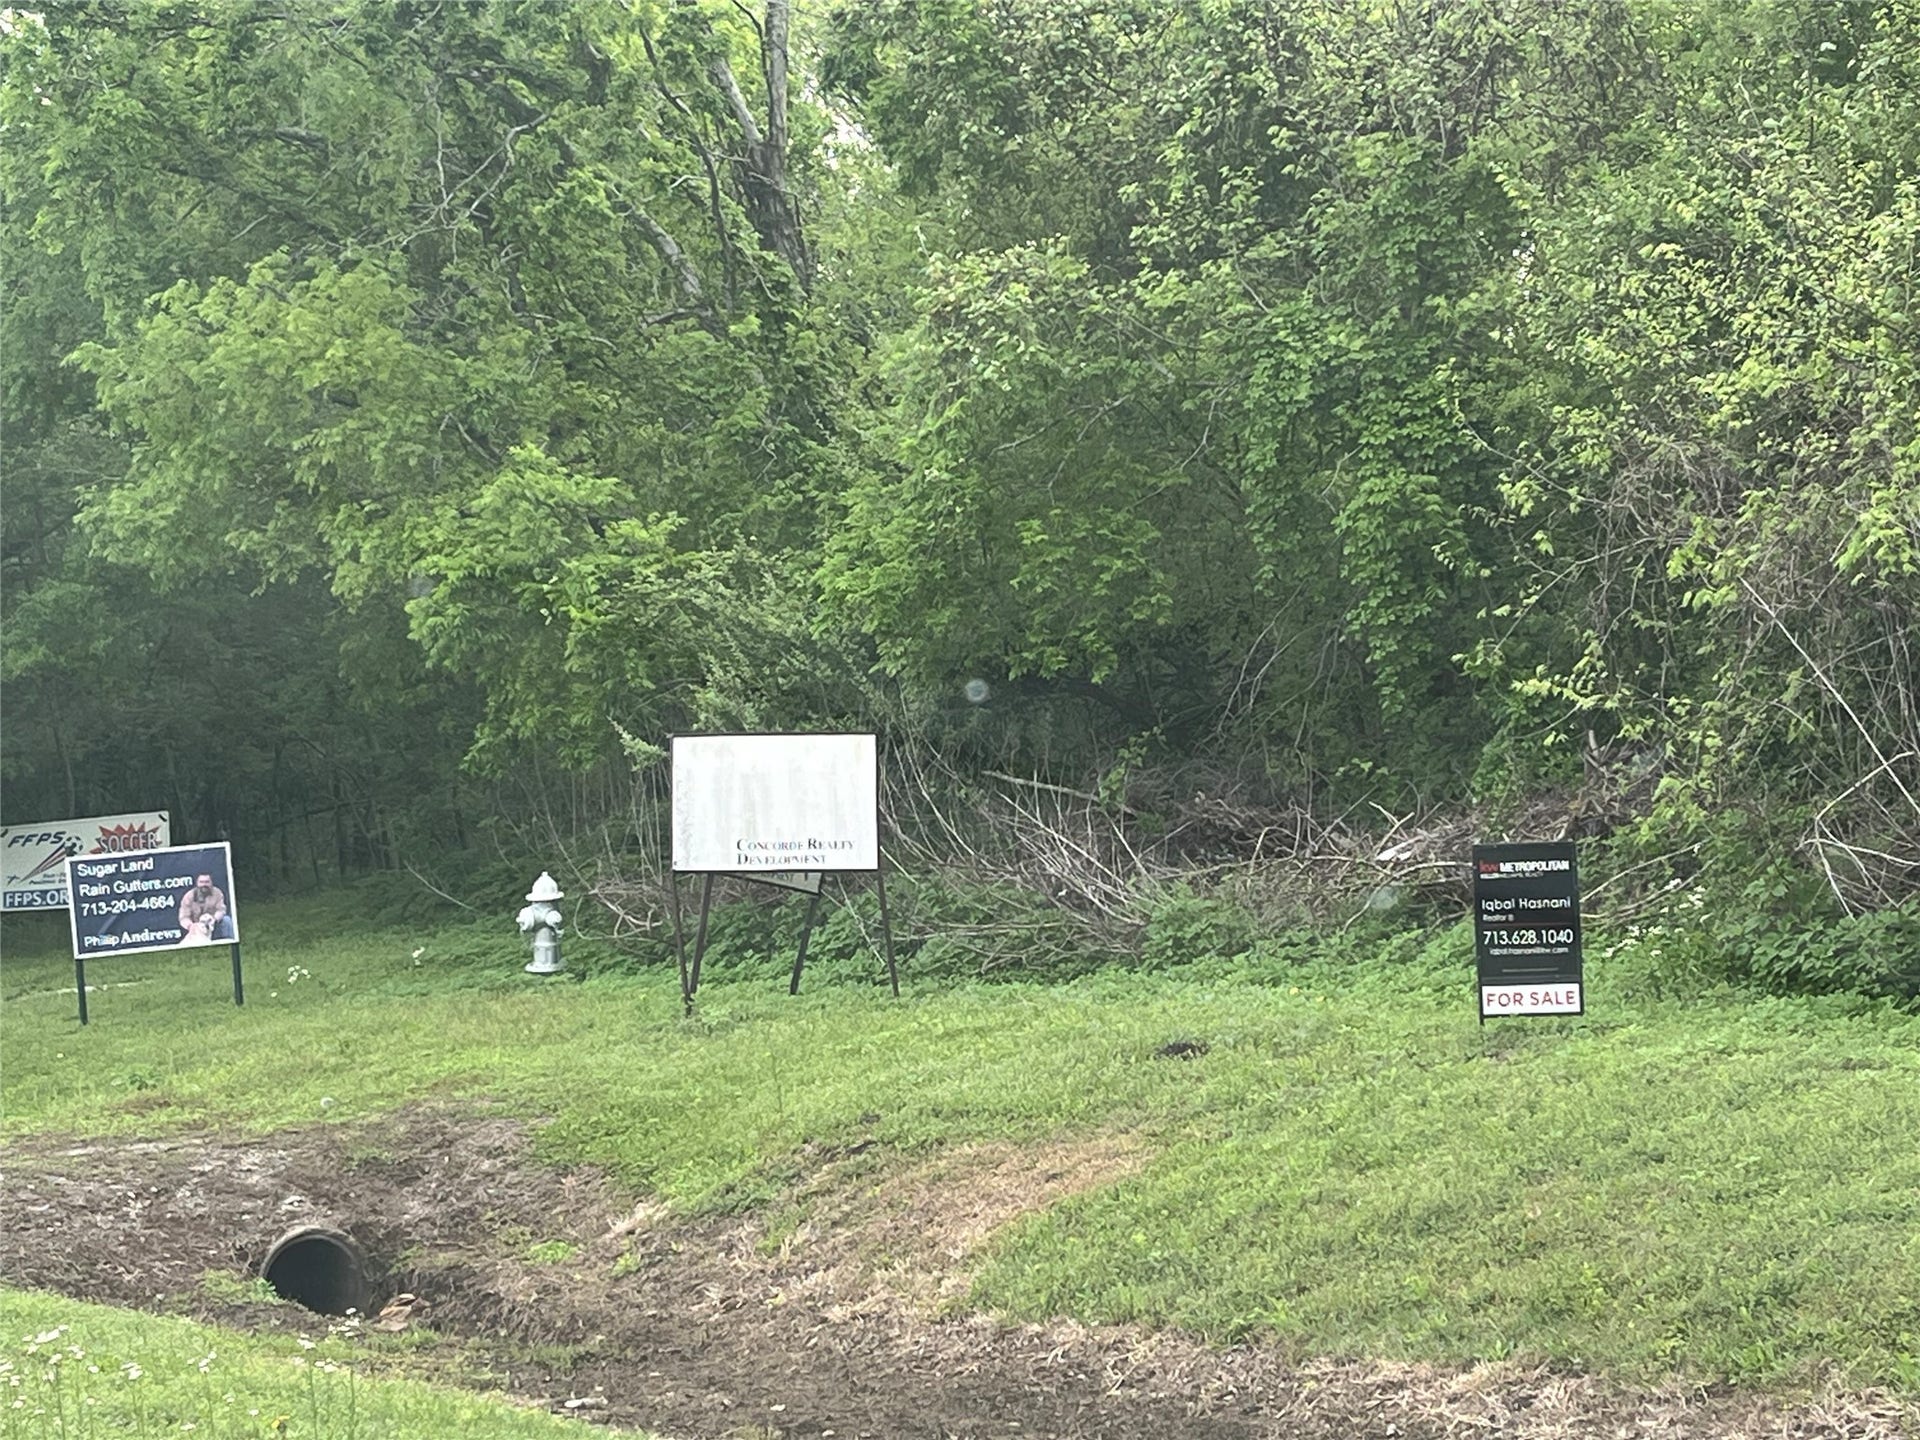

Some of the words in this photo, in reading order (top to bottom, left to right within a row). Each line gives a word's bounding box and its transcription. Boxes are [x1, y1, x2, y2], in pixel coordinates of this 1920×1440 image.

[8, 831, 67, 848] FFPS
[100, 831, 158, 853] SOCCER
[77, 863, 118, 878] Sugar
[120, 857, 154, 873] Land
[1499, 860, 1570, 873] METROPOLITAN
[79, 883, 110, 897] Rain
[113, 876, 193, 894] Gutters.com
[81, 895, 175, 917] 713-204-4664
[1481, 900, 1516, 912] Iqbal
[1519, 897, 1571, 910] Hasnani
[121, 929, 182, 945] Andrews
[1483, 929, 1574, 945] 713.628.1040
[1486, 992, 1524, 1008] FOR
[1530, 991, 1576, 1006] SALE
